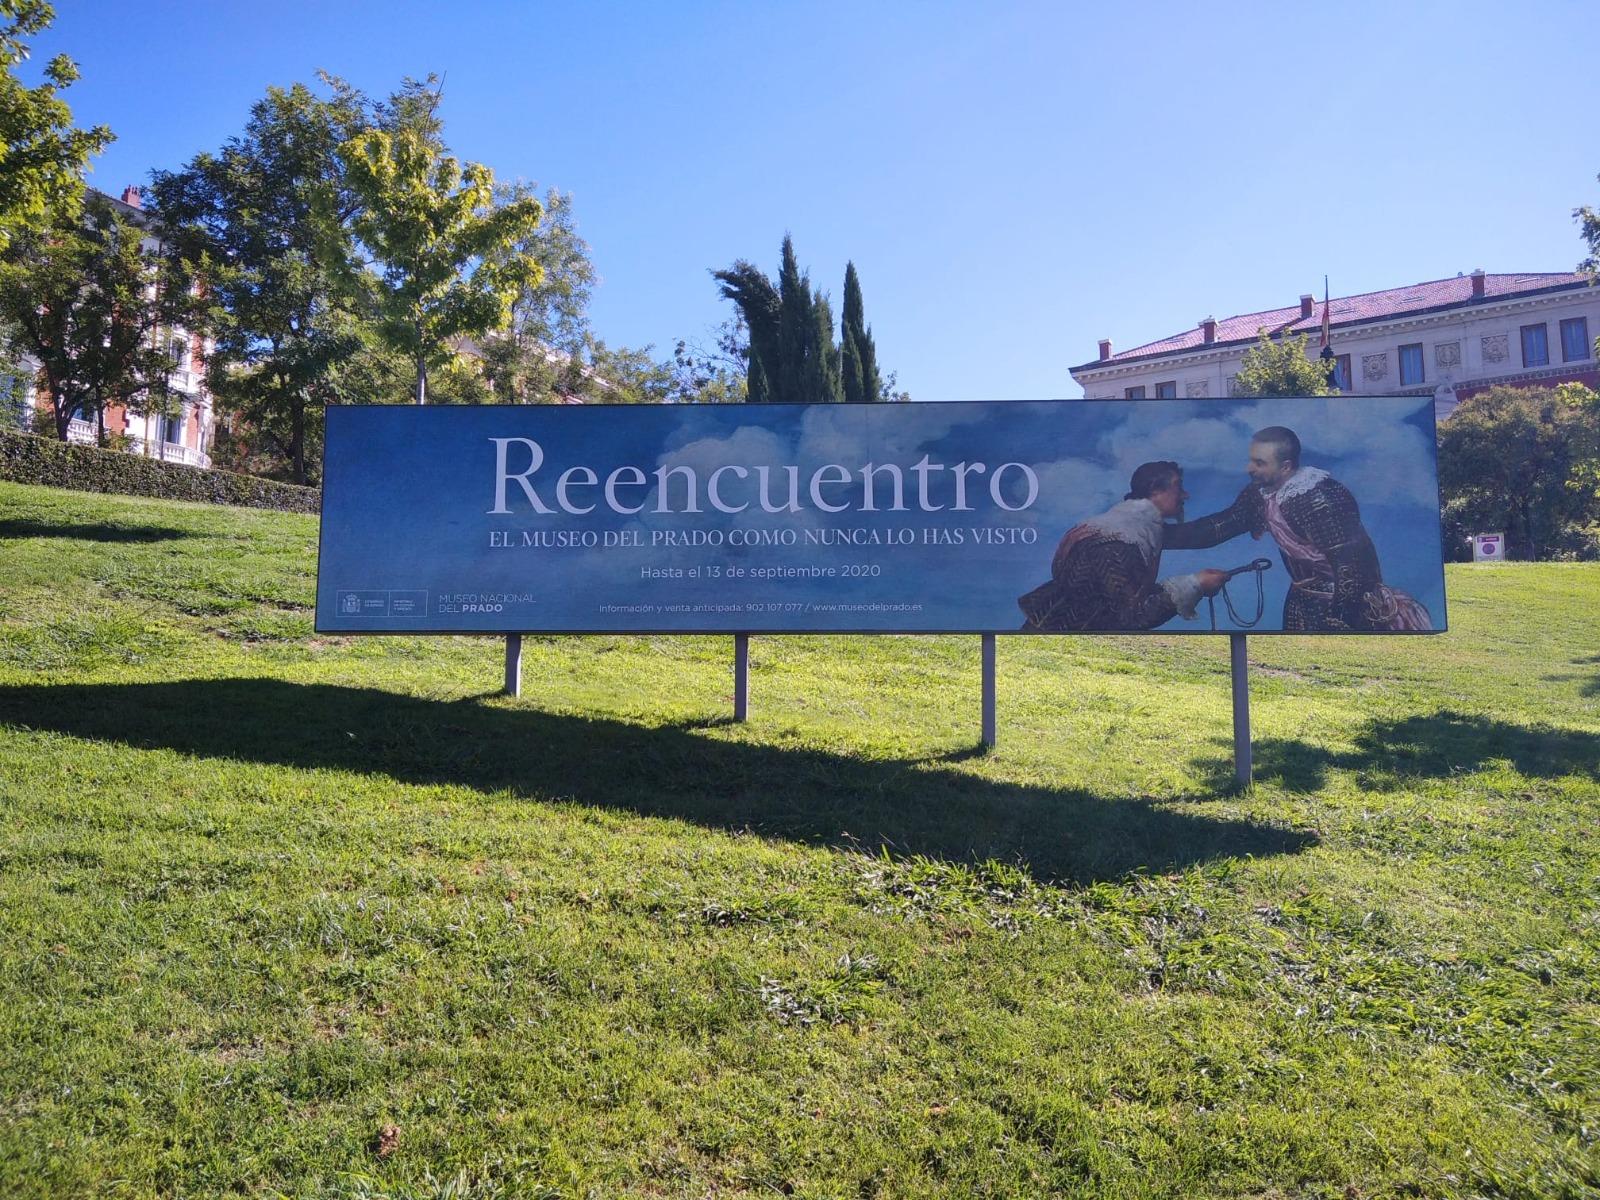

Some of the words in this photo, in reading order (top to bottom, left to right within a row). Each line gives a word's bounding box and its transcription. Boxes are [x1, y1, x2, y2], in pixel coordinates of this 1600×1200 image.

[486, 436, 1040, 515] Reencuentro
[489, 531, 515, 547] EL
[522, 530, 598, 547] MUSEO
[603, 530, 644, 547] DEL
[652, 529, 724, 546] PRADO
[728, 529, 797, 546] COMO
[804, 528, 882, 545] NUNCA
[887, 528, 915, 545] LO
[923, 528, 964, 545] HAS
[971, 527, 1038, 545] VISTO
[641, 566, 683, 578] Hasta
[688, 566, 701, 578] el
[706, 566, 721, 578] 13
[726, 565, 745, 578] de
[750, 565, 836, 579] septiembre
[841, 565, 881, 577] 2020
[439, 594, 478, 603] MUSEO
[480, 593, 537, 603] NACIONAL
[439, 604, 460, 613] DEL
[462, 604, 503, 613] PRADO
[599, 603, 654, 613] Información
[657, 606, 663, 614] y
[665, 605, 691, 613] venta
[693, 604, 744, 614] anticipada:
[746, 603, 765, 612] 902
[767, 603, 783, 612] 107
